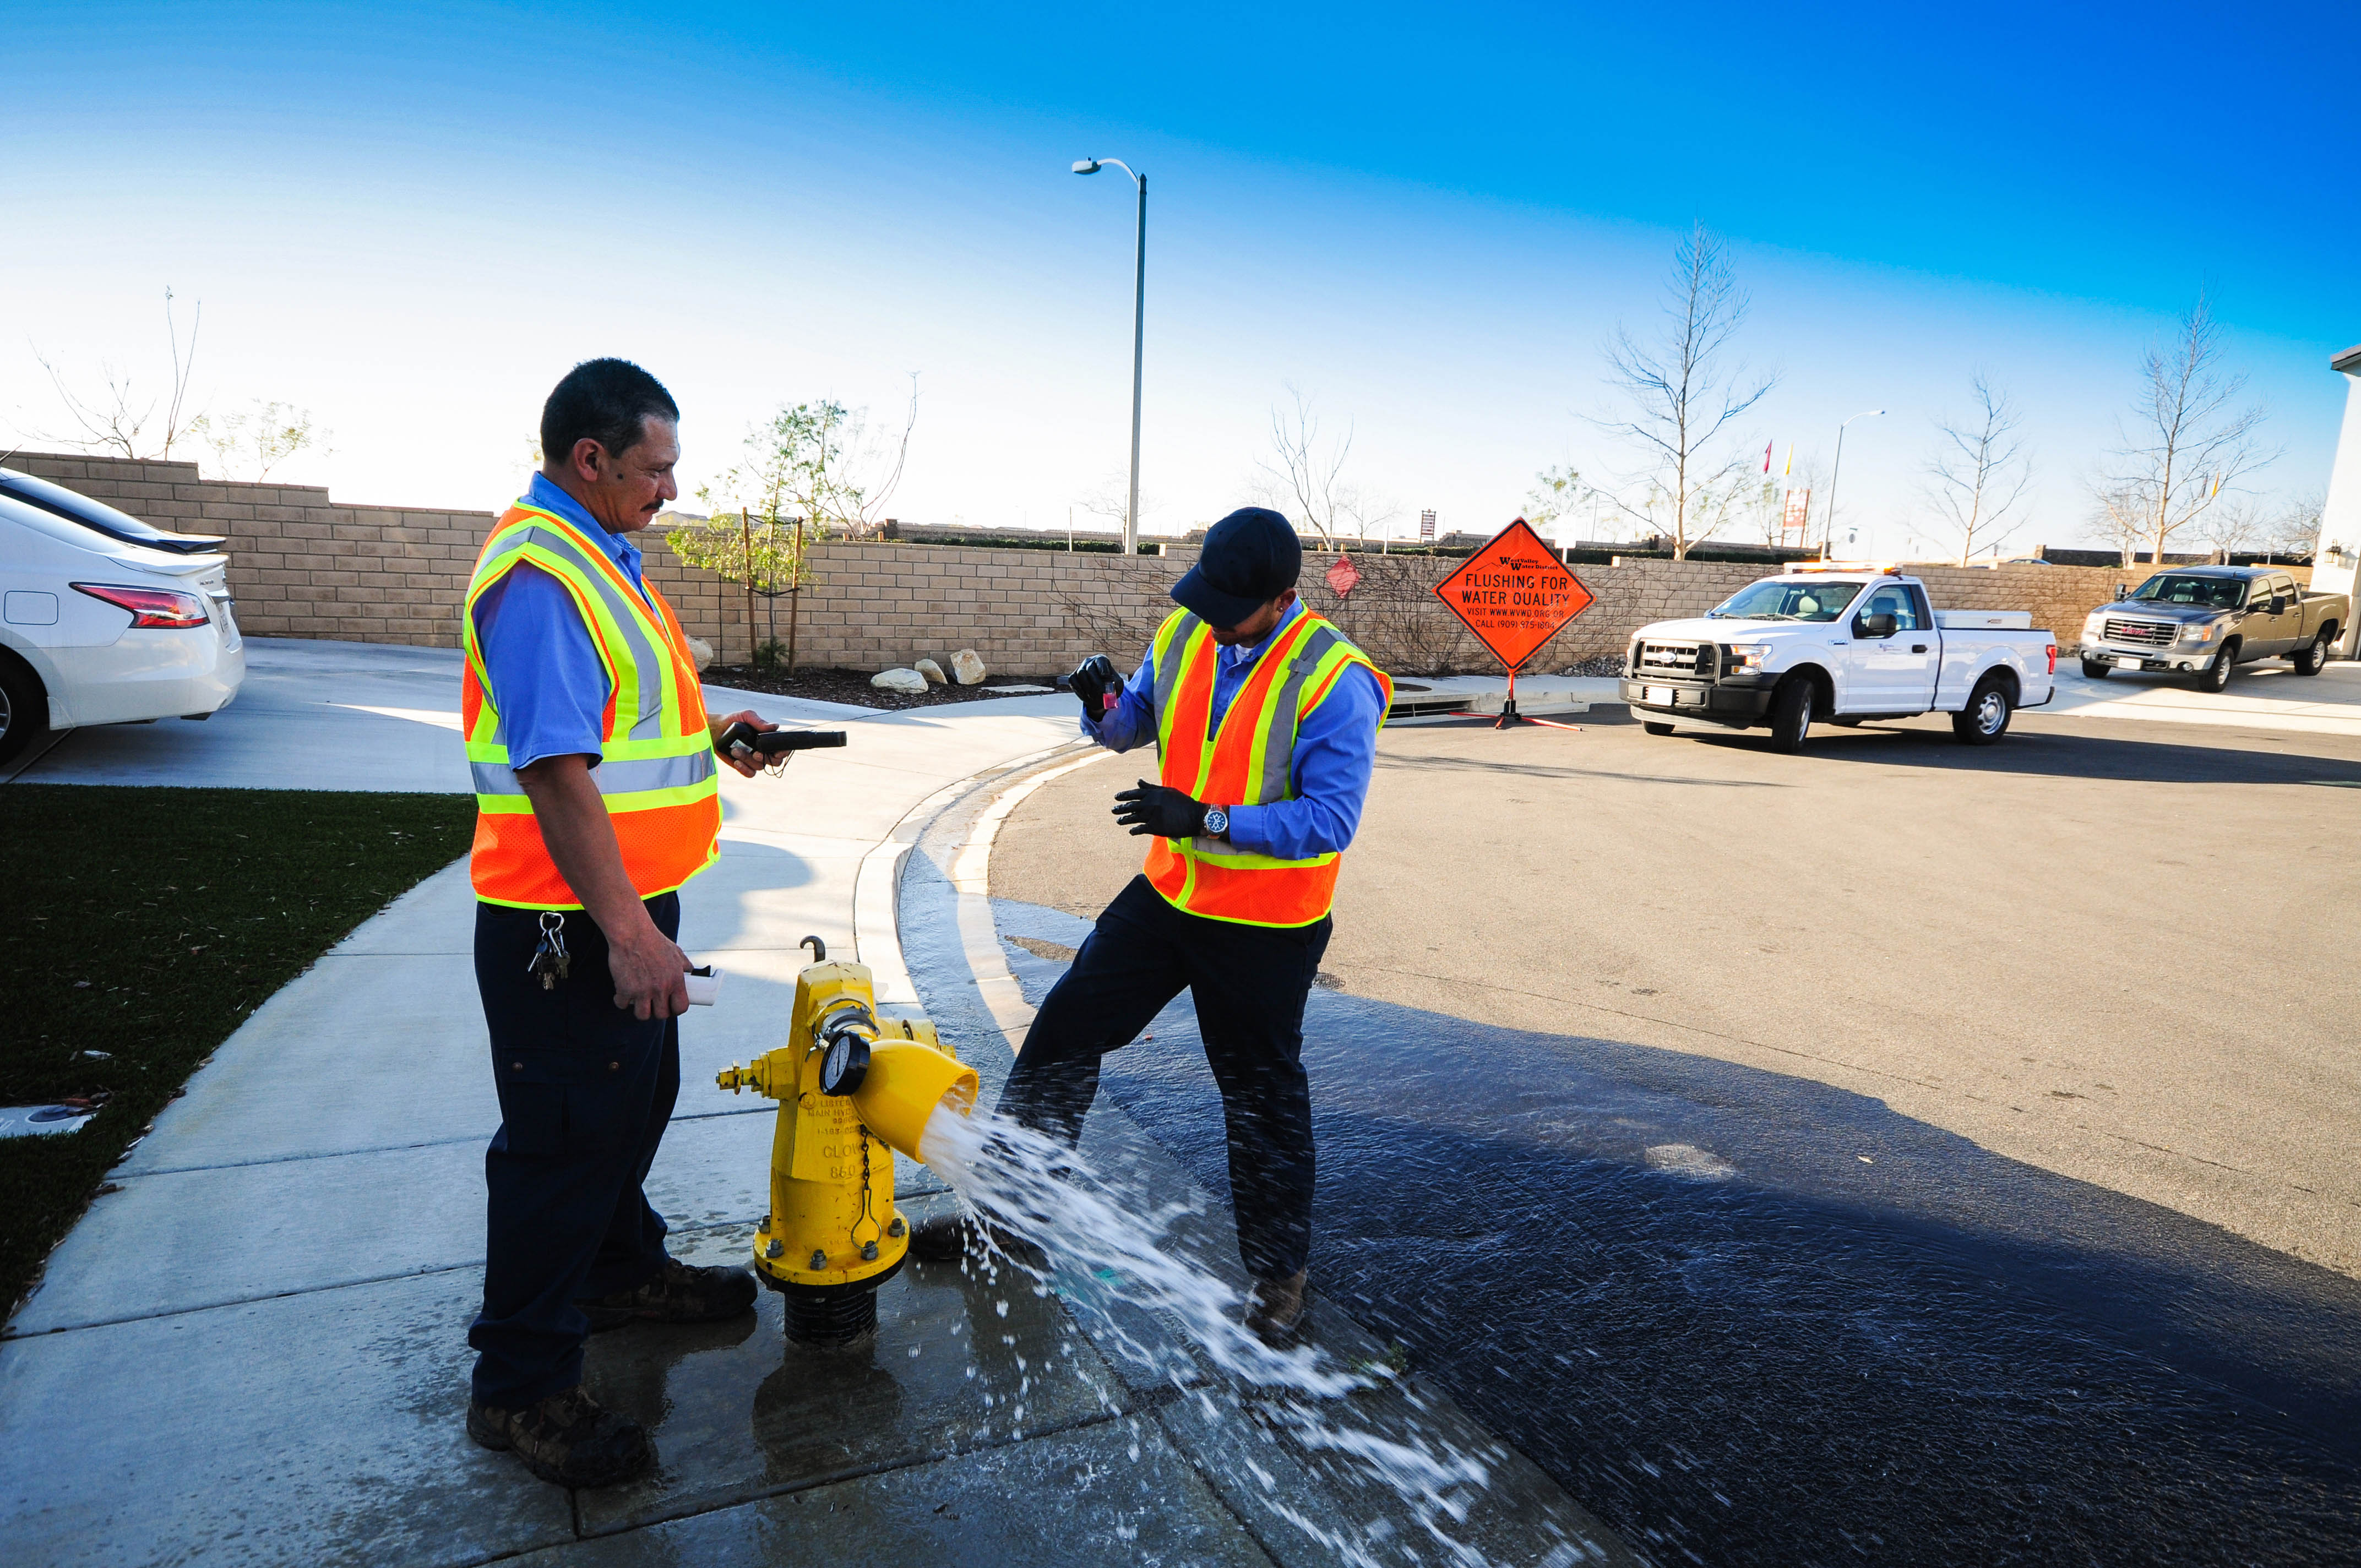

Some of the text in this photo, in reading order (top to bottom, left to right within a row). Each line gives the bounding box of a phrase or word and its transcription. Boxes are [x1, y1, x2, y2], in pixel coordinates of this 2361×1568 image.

[1510, 563, 1534, 571] Water
[1466, 574, 1568, 590] FLUSHING FOR
[1462, 590, 1570, 607] WATER QUALITY
[1467, 607, 1487, 616] VISIT
[1490, 608, 1550, 617] WWW.WVWD.ORG
[1476, 619, 1555, 629] CALL (909) 875-1804
